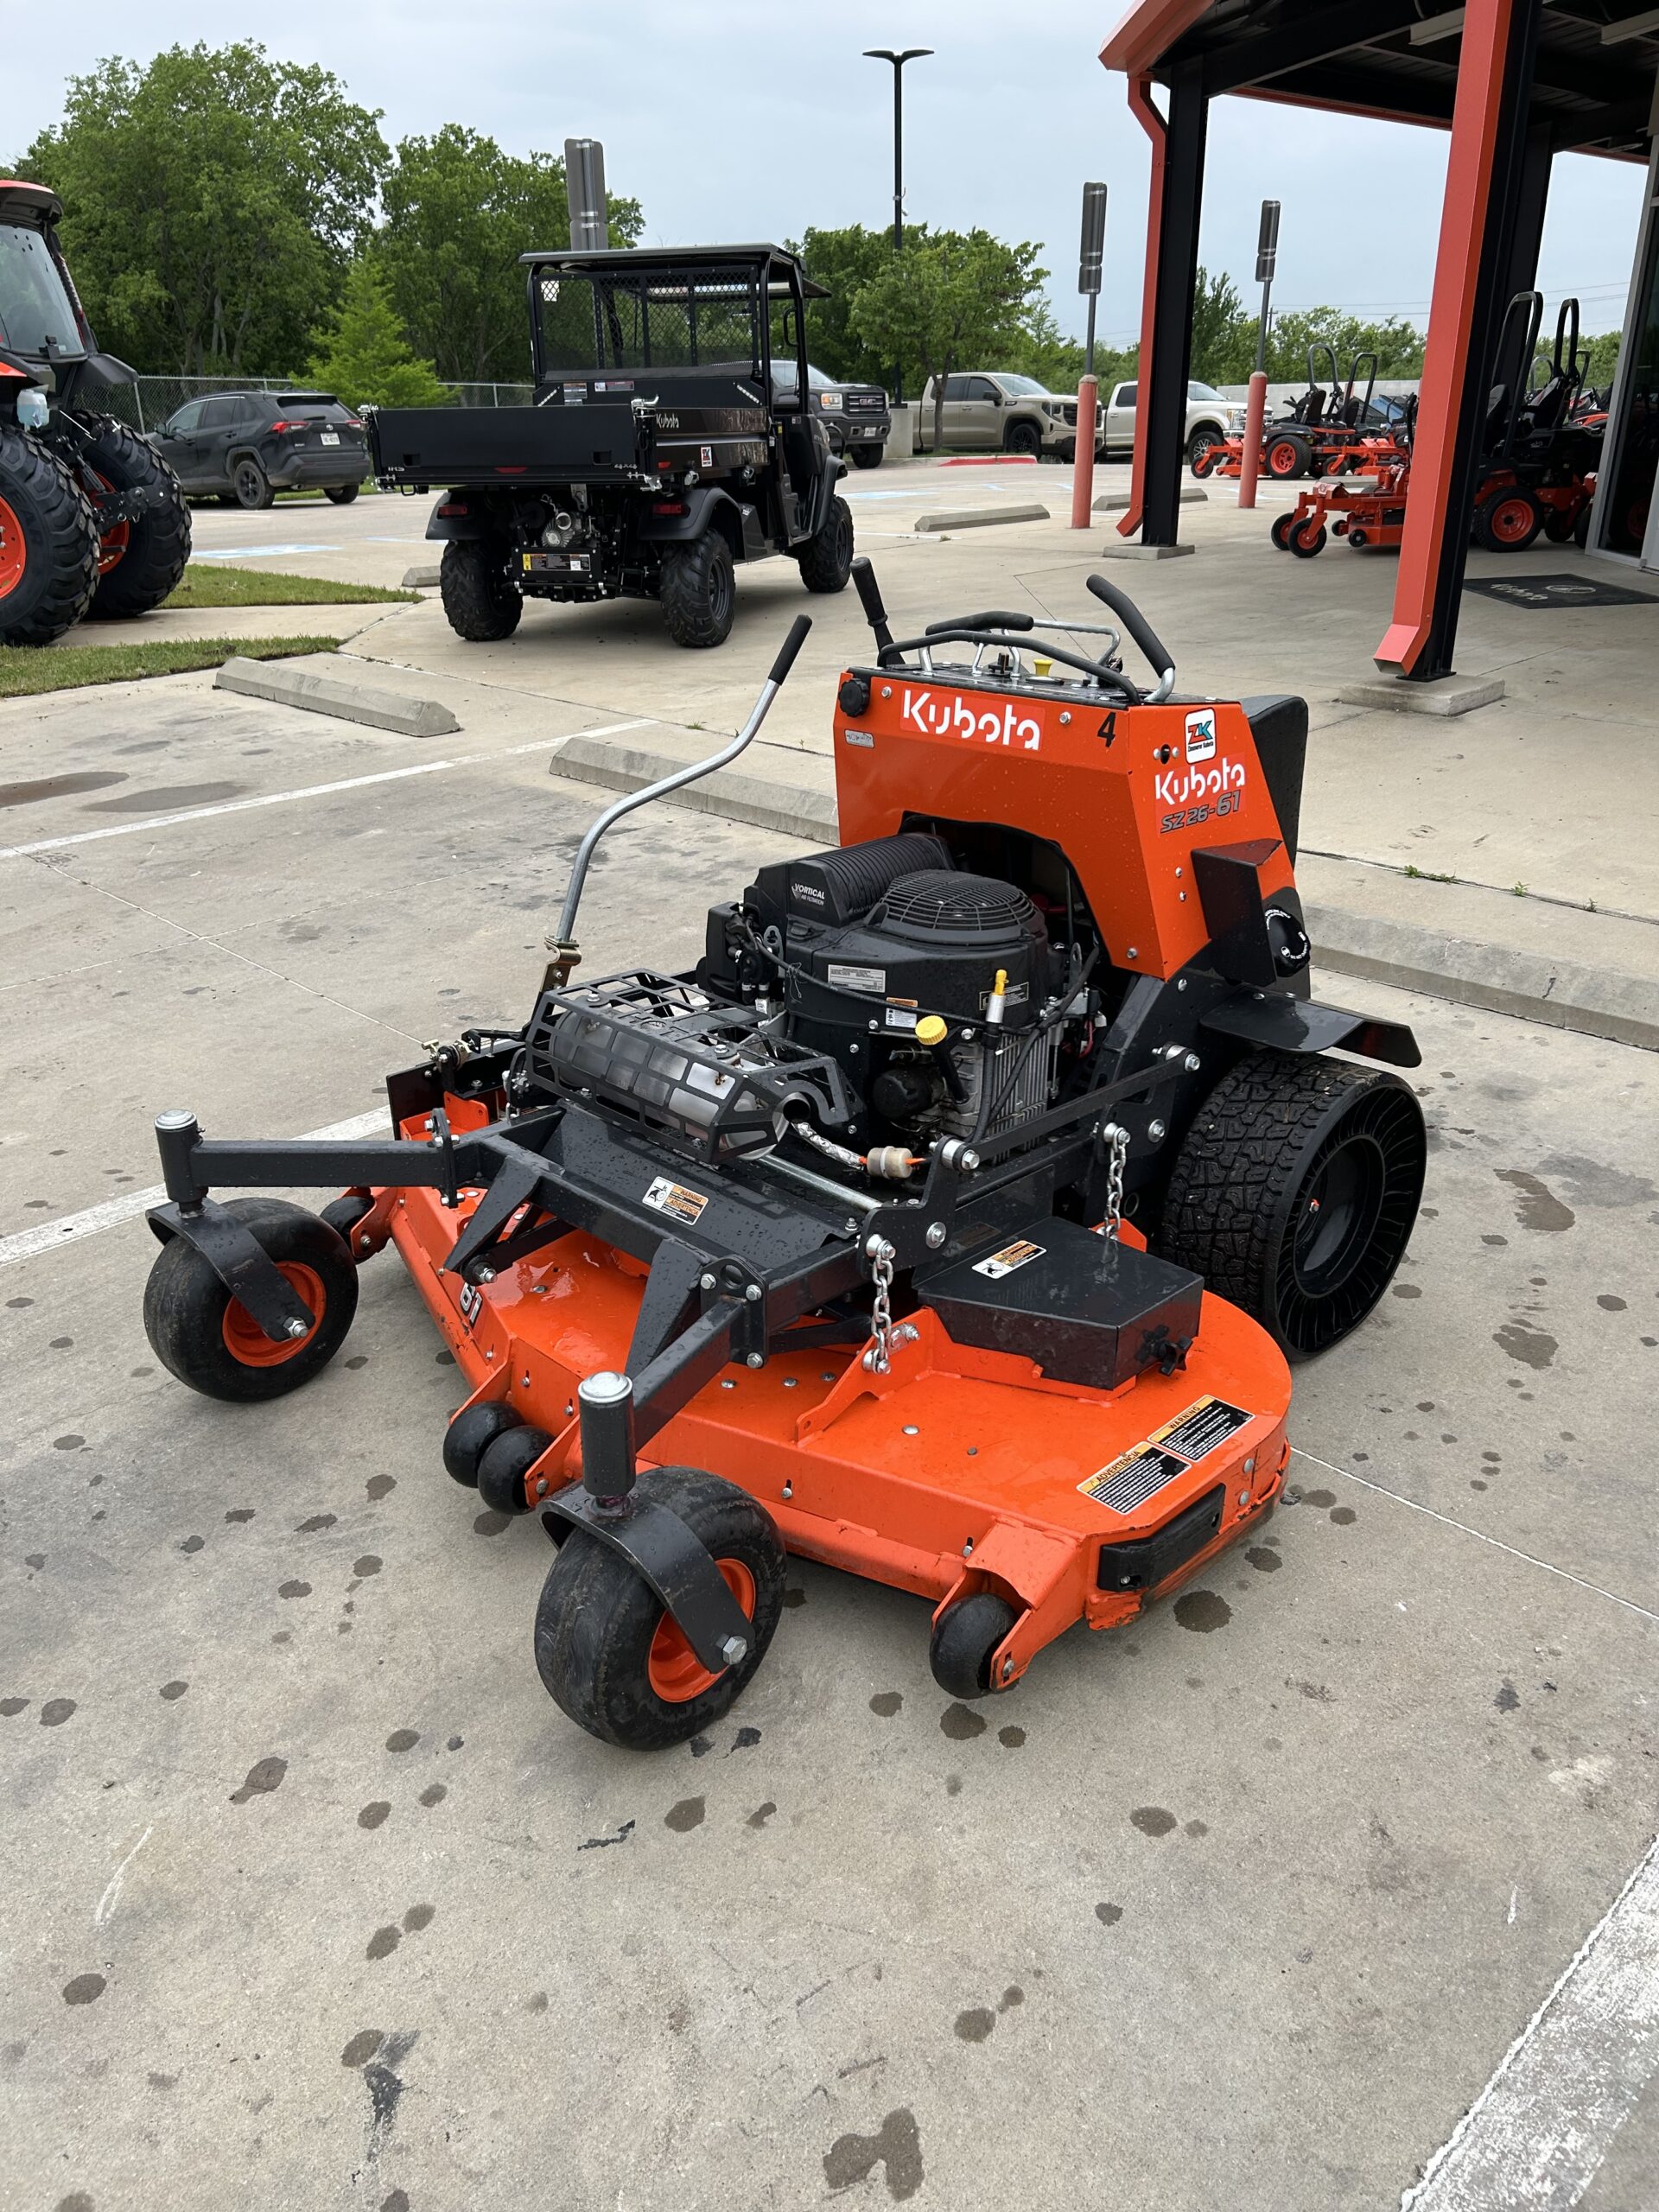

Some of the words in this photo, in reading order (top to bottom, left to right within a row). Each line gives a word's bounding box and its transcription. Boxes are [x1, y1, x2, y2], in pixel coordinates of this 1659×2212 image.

[657, 413, 679, 429] Kubota
[903, 690, 1040, 751] Kubota
[1096, 711, 1116, 748] 4
[1187, 720, 1214, 746] ZK
[1154, 757, 1245, 805] Kubota
[795, 882, 825, 899] VORTICAL
[1168, 1406, 1201, 1430] WARNING
[1096, 1451, 1141, 1483] ADVERTENCIA
